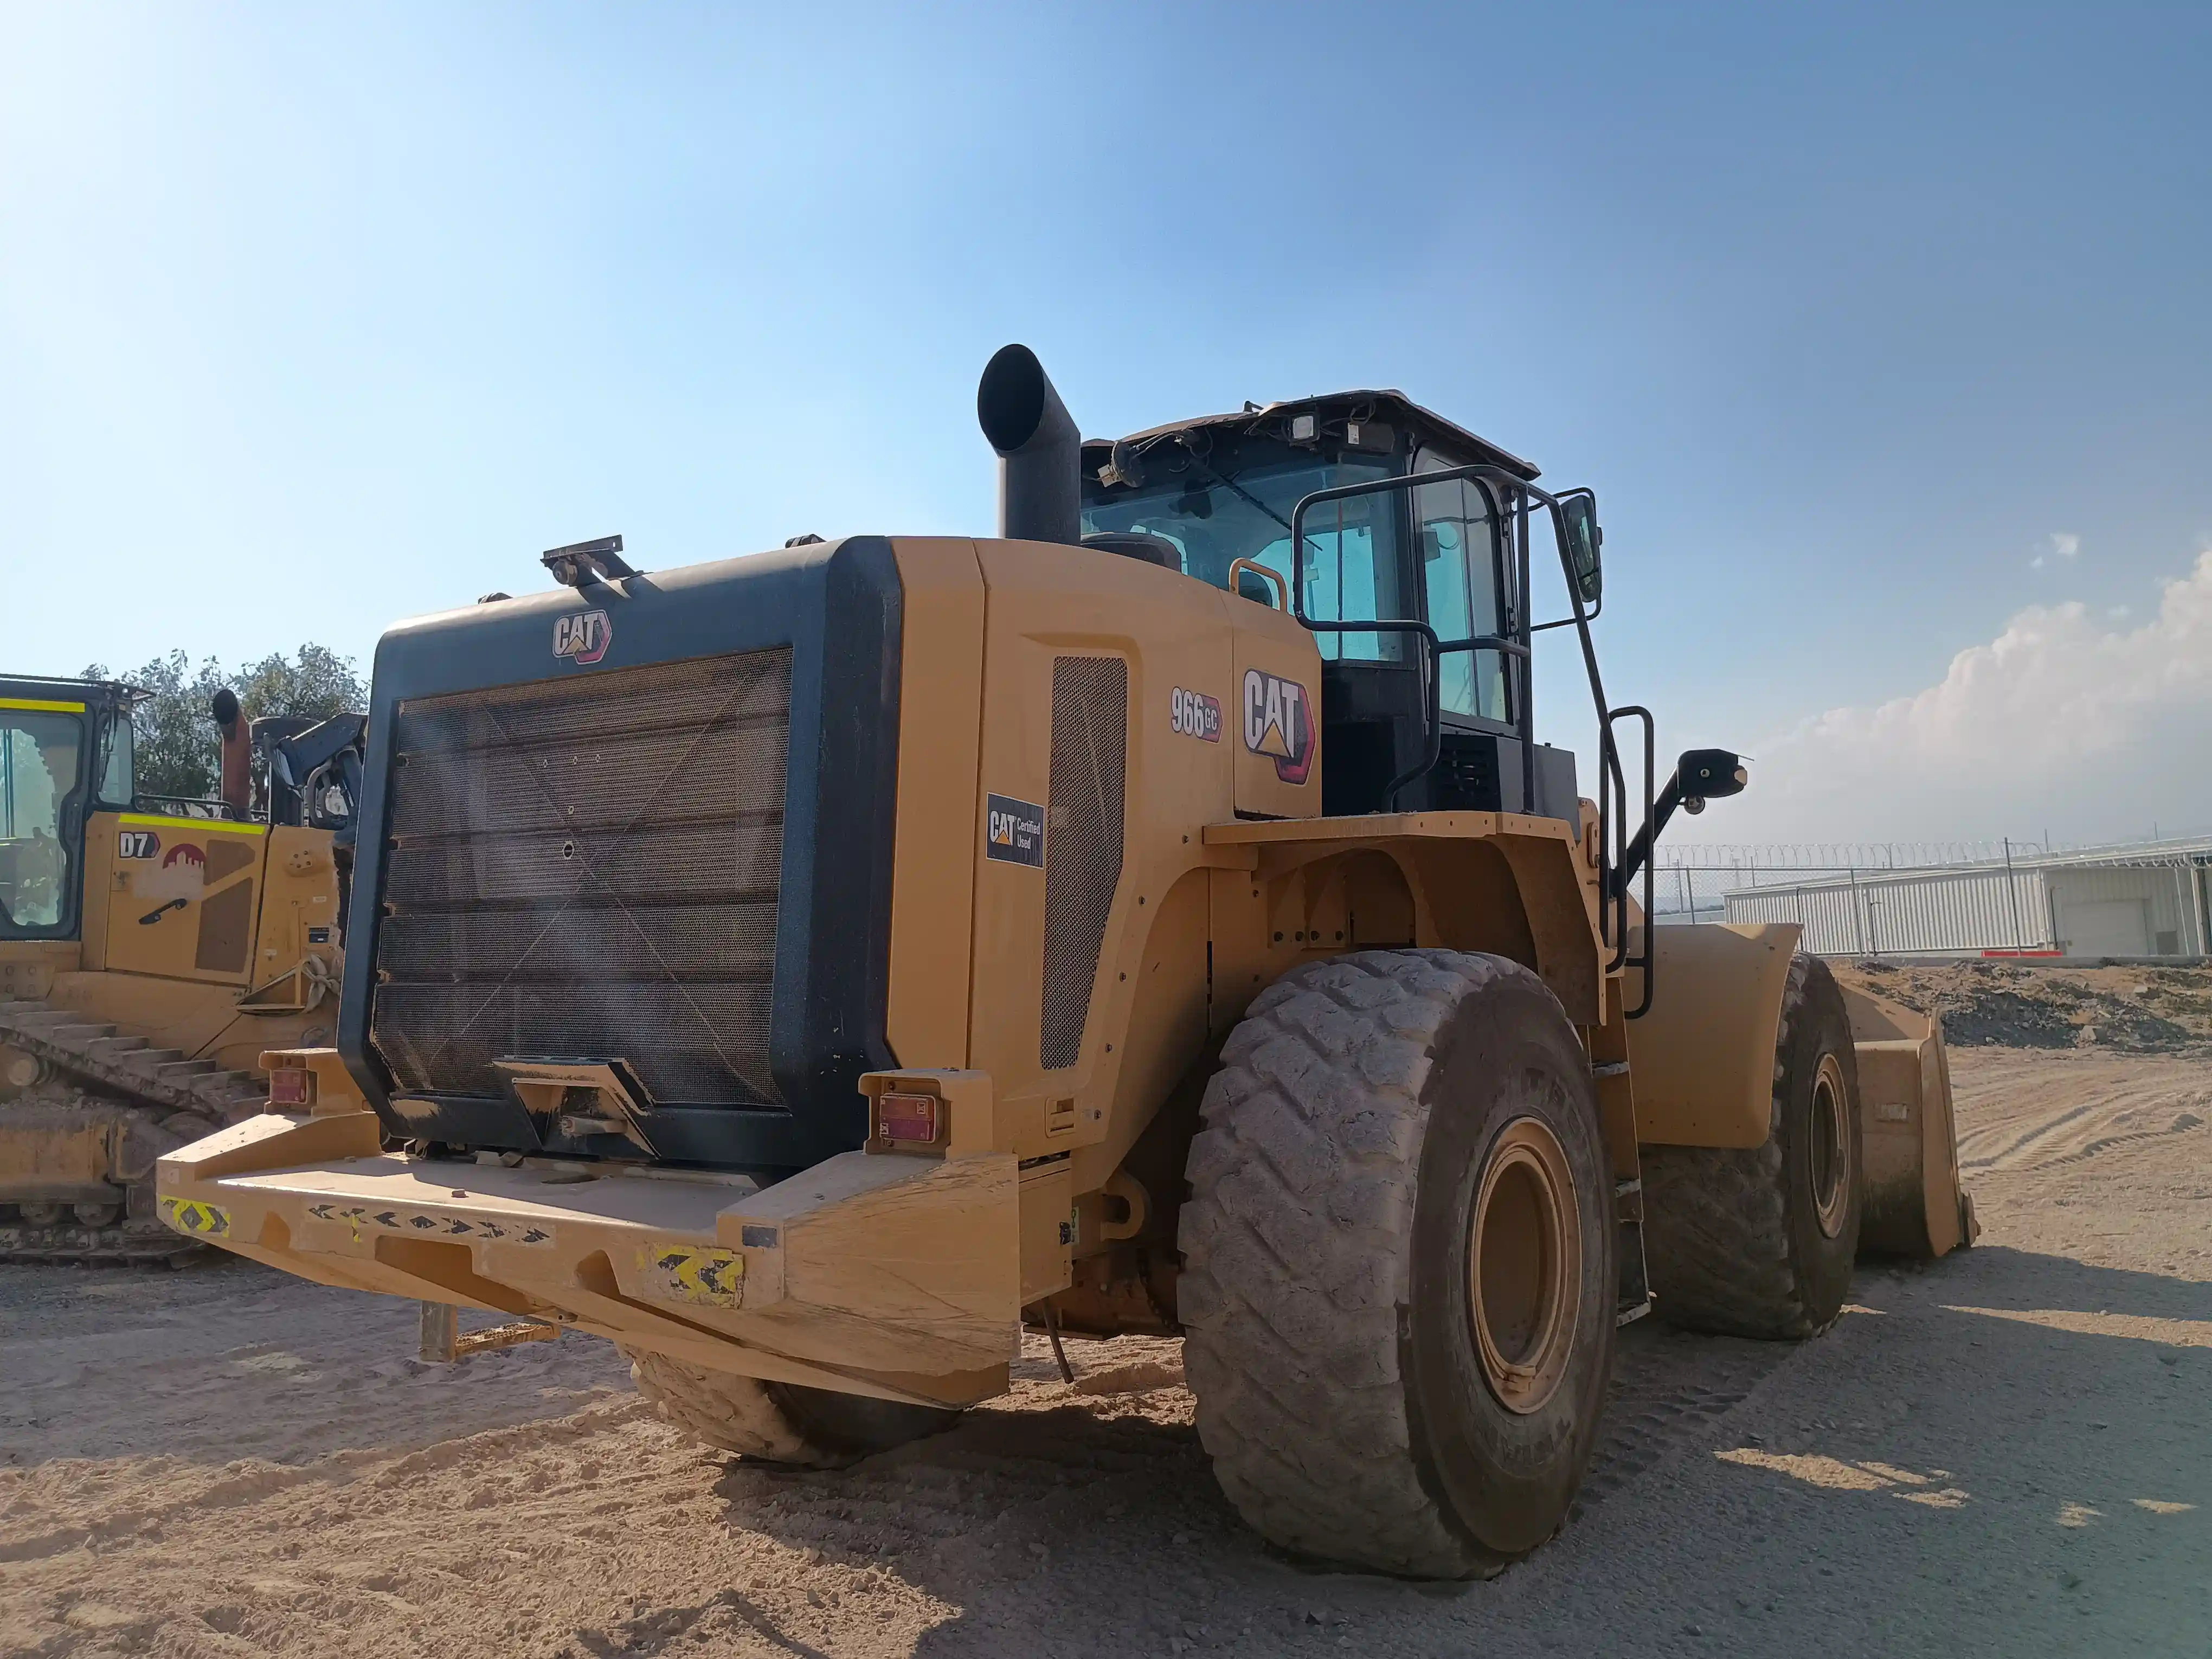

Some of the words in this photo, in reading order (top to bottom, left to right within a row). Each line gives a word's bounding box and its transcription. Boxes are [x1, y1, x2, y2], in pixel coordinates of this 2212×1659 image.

[555, 612, 599, 655] CAT
[1171, 687, 1204, 738] 966
[1205, 707, 1218, 731] GC
[1244, 670, 1299, 758] CAT
[989, 810, 1015, 846] CAT
[1017, 817, 1040, 835] Certified
[1017, 834, 1031, 850] Used
[120, 833, 148, 857] D7
